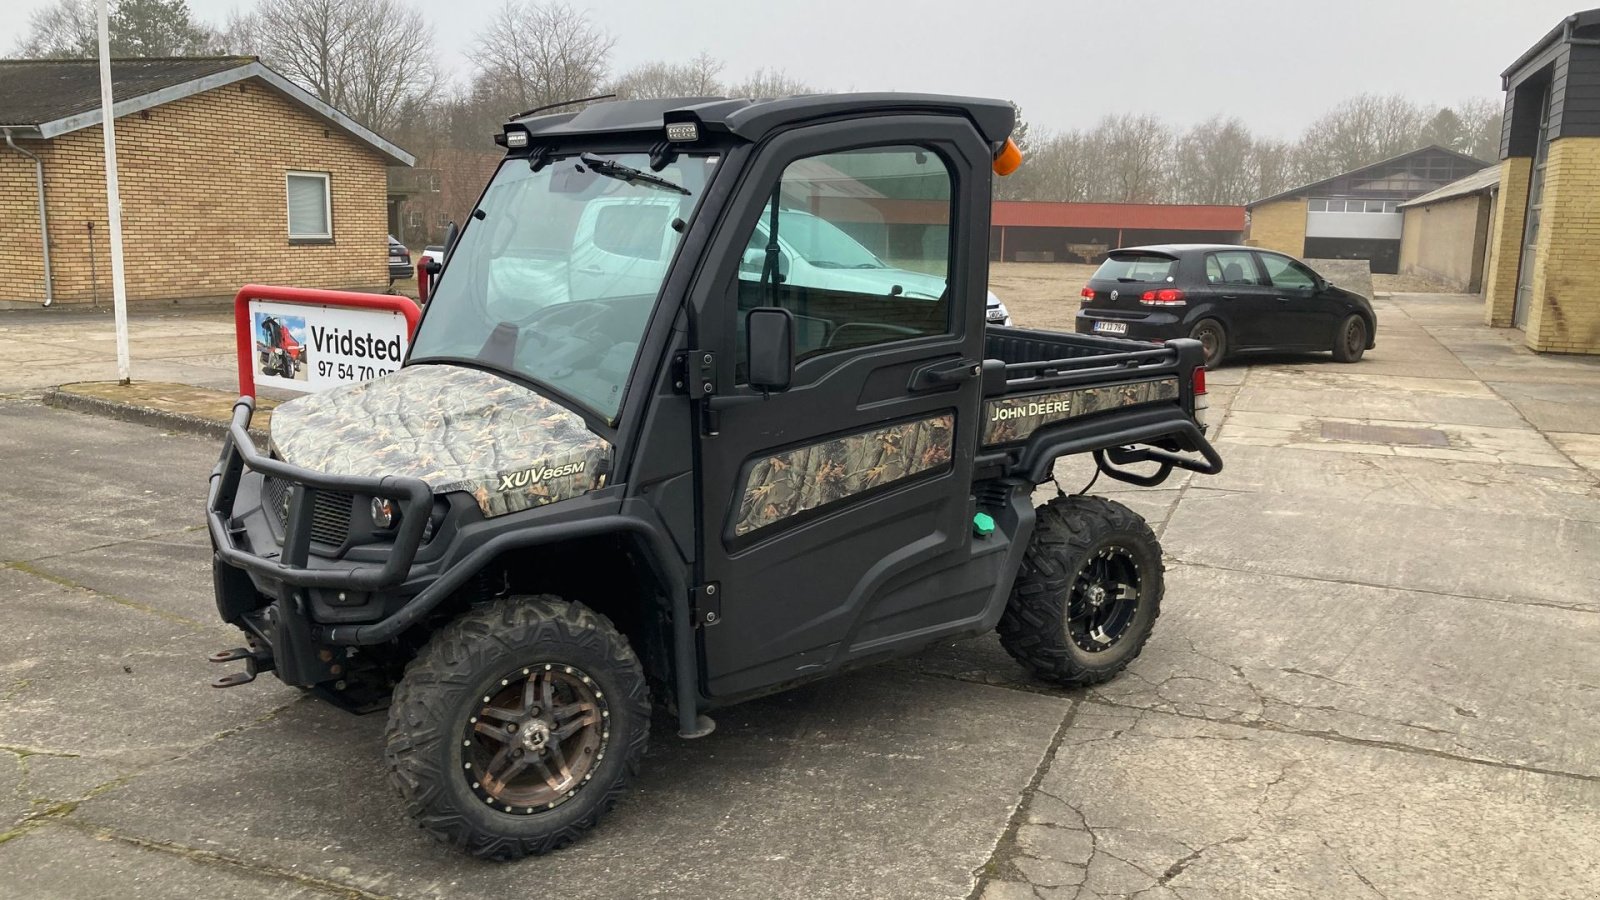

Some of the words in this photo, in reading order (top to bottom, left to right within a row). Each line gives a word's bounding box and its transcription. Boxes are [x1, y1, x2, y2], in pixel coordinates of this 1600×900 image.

[311, 325, 401, 362] Vridsted
[318, 360, 334, 377] 97
[338, 362, 354, 380] 54
[358, 365, 375, 381] 70
[991, 406, 1026, 421] JOHN
[1028, 400, 1070, 416] DEERE
